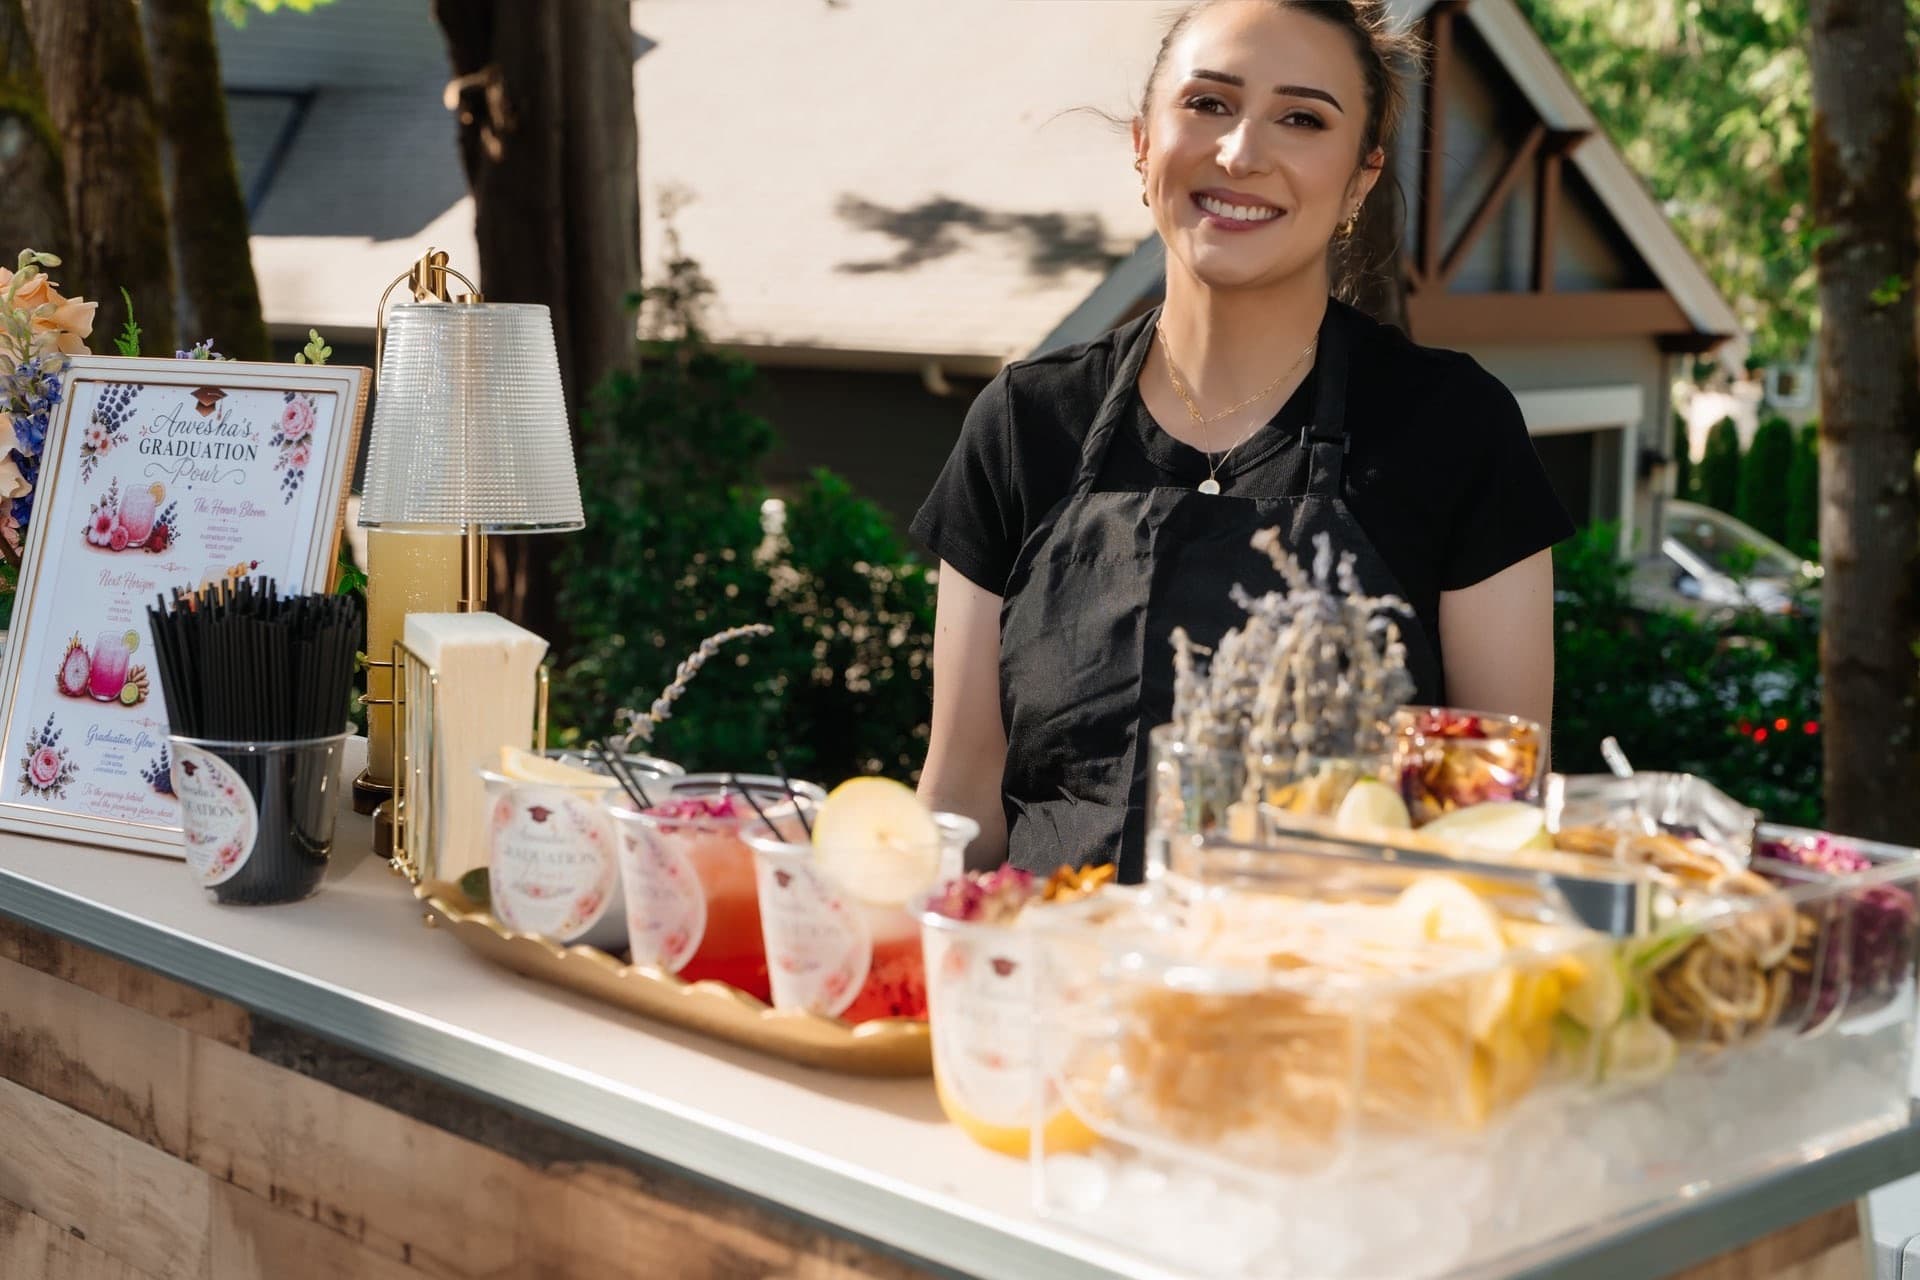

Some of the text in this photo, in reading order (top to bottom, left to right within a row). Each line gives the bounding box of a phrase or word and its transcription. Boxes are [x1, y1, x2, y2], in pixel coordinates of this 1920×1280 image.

[139, 438, 258, 461] GRADUATION
[150, 457, 242, 485] Pour
[193, 497, 208, 513] The
[238, 500, 266, 519] Bloom
[99, 568, 123, 587] Next
[85, 723, 156, 753] Graduation Glow
